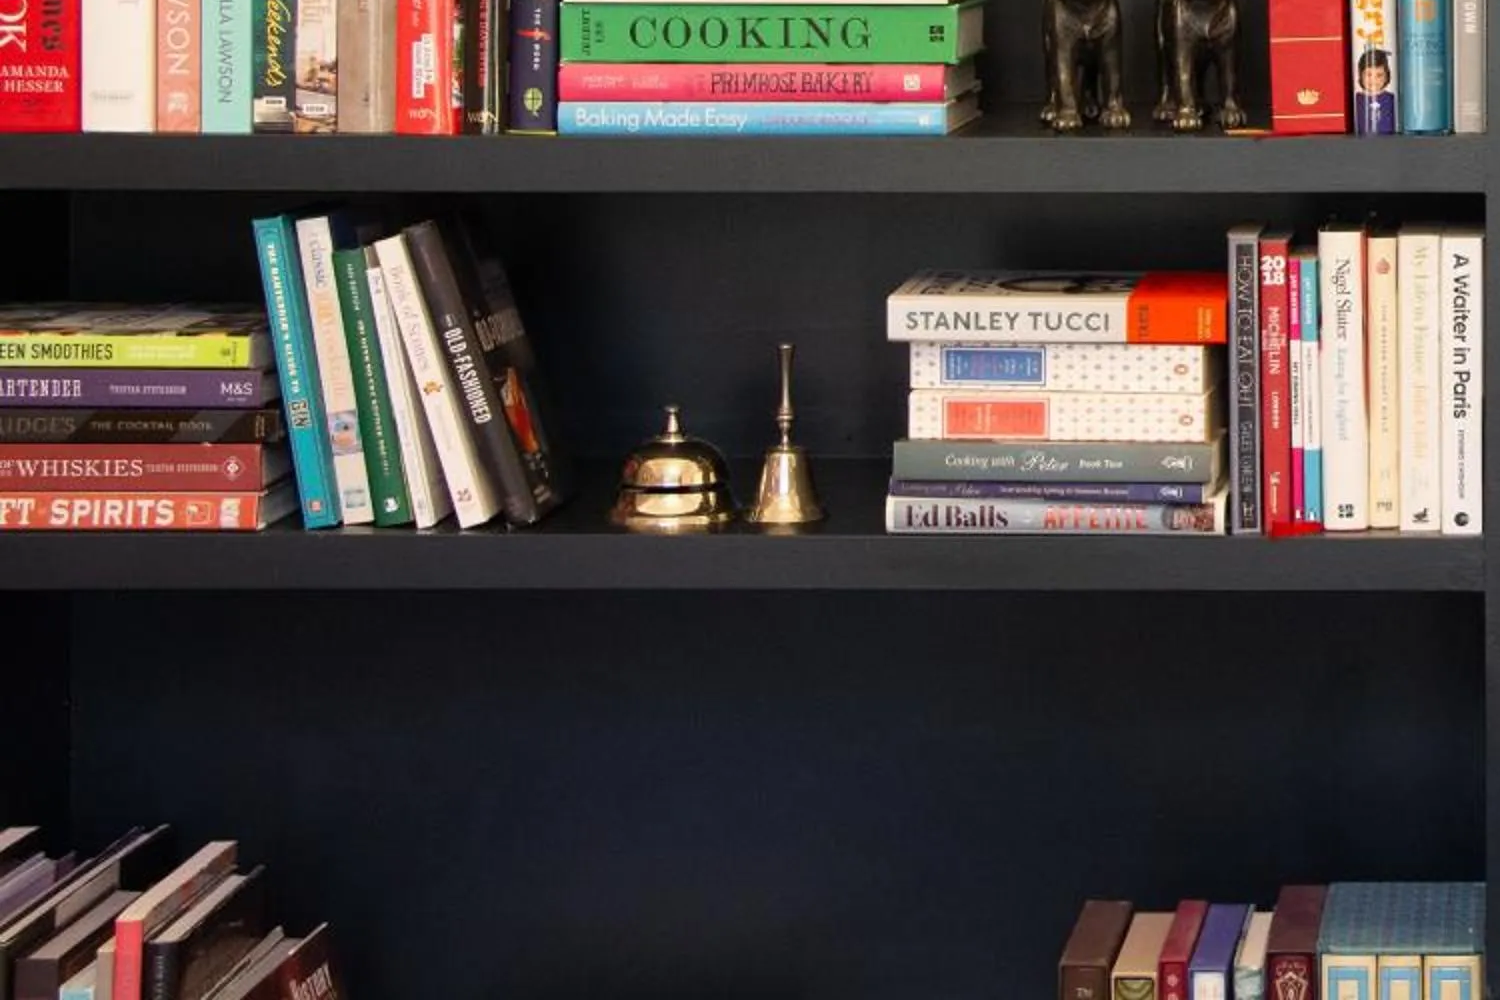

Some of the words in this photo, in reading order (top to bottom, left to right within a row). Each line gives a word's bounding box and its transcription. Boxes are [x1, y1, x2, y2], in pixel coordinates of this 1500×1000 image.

[581, 8, 590, 55] JEREMY
[630, 15, 872, 49] COOKING
[1, 65, 69, 78] AMANDA
[218, 30, 235, 104] LAWSON
[4, 79, 64, 93] HESSER
[576, 109, 640, 129] Baking
[646, 109, 700, 127] Made
[705, 110, 747, 130] Easy
[1453, 254, 1470, 268] A
[1237, 256, 1253, 301] HOW
[1331, 259, 1351, 295] Nigel
[1237, 309, 1253, 331] TO
[1336, 299, 1350, 339] Slater
[1453, 275, 1470, 342] Waiter
[906, 312, 1025, 332] STANLEY
[1029, 313, 1109, 332] TUCCI
[0, 338, 27, 360] EEN
[31, 337, 113, 361] SMOOTHIES
[1237, 335, 1253, 366] EAT
[1453, 348, 1470, 364] in
[221, 383, 252, 396] M&S
[1237, 372, 1253, 408] OUT
[1453, 371, 1470, 419] Paris
[90, 421, 109, 429] THE
[116, 421, 174, 430] COCKTAIL
[17, 460, 143, 478] WHISKIES
[906, 505, 939, 528] Ed
[944, 505, 1008, 529] Balls
[1044, 506, 1148, 529] APPETITE
